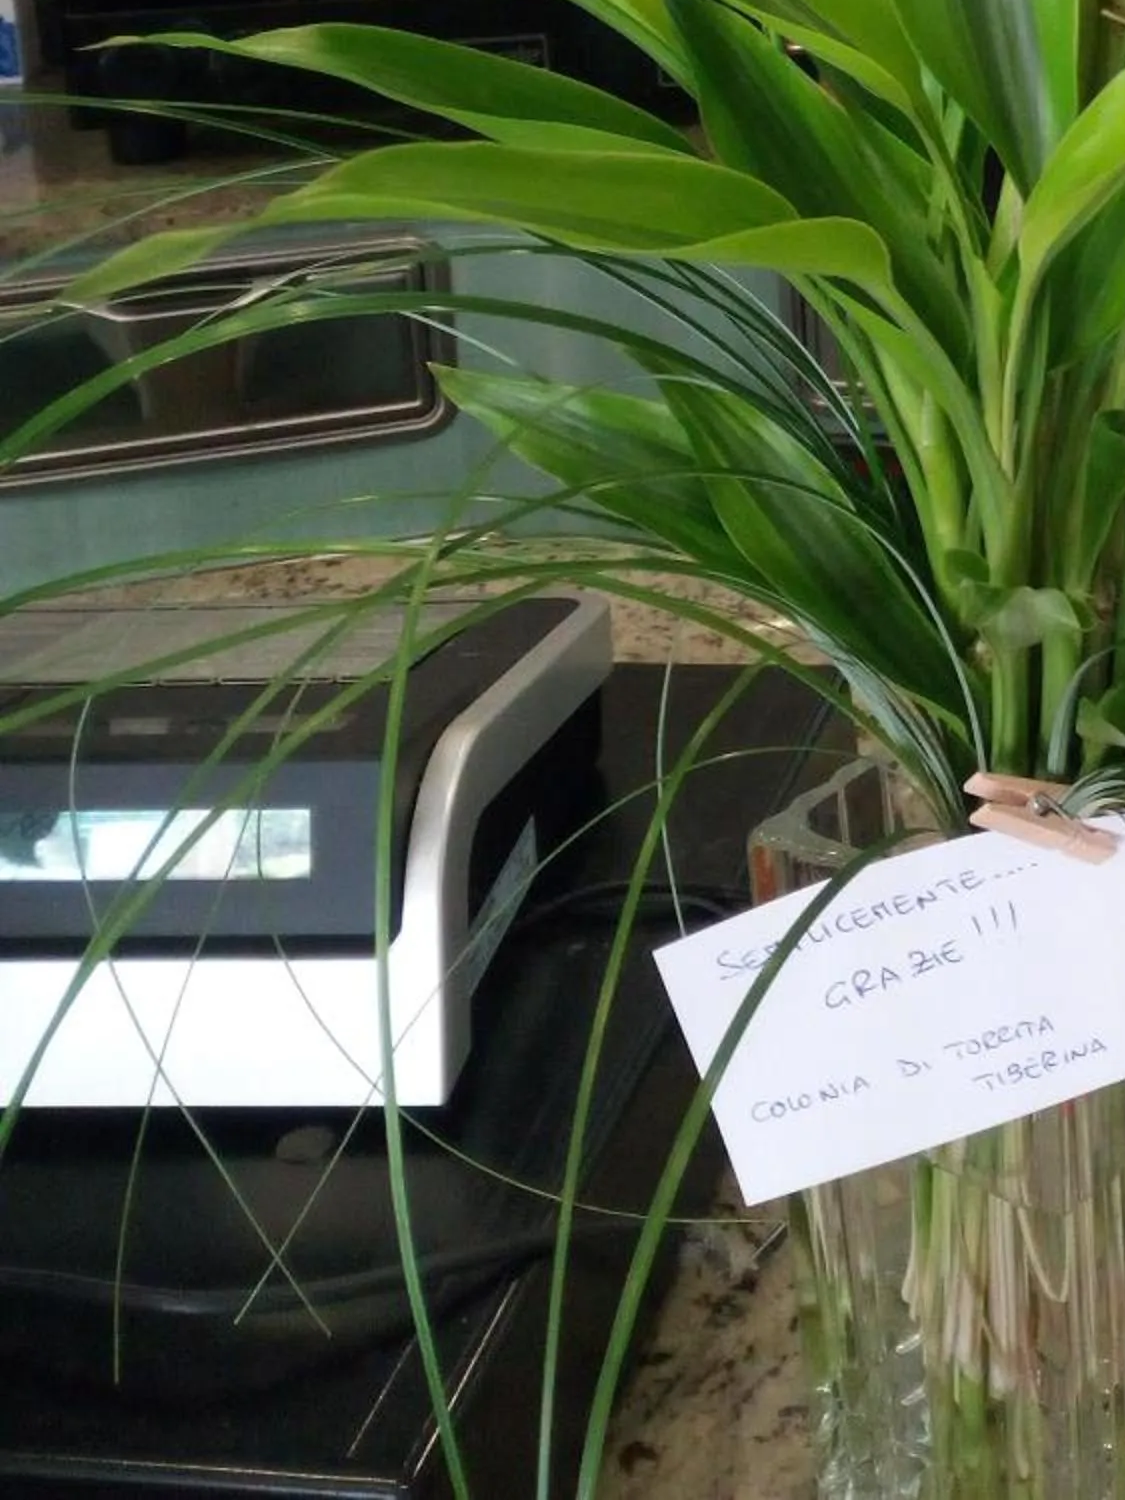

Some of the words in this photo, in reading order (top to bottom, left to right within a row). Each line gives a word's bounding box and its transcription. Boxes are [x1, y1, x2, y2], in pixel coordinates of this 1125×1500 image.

[750, 1074, 870, 1124] COLONIA
[896, 1056, 933, 1078] DI
[972, 1037, 1108, 1091] TIBERINA
